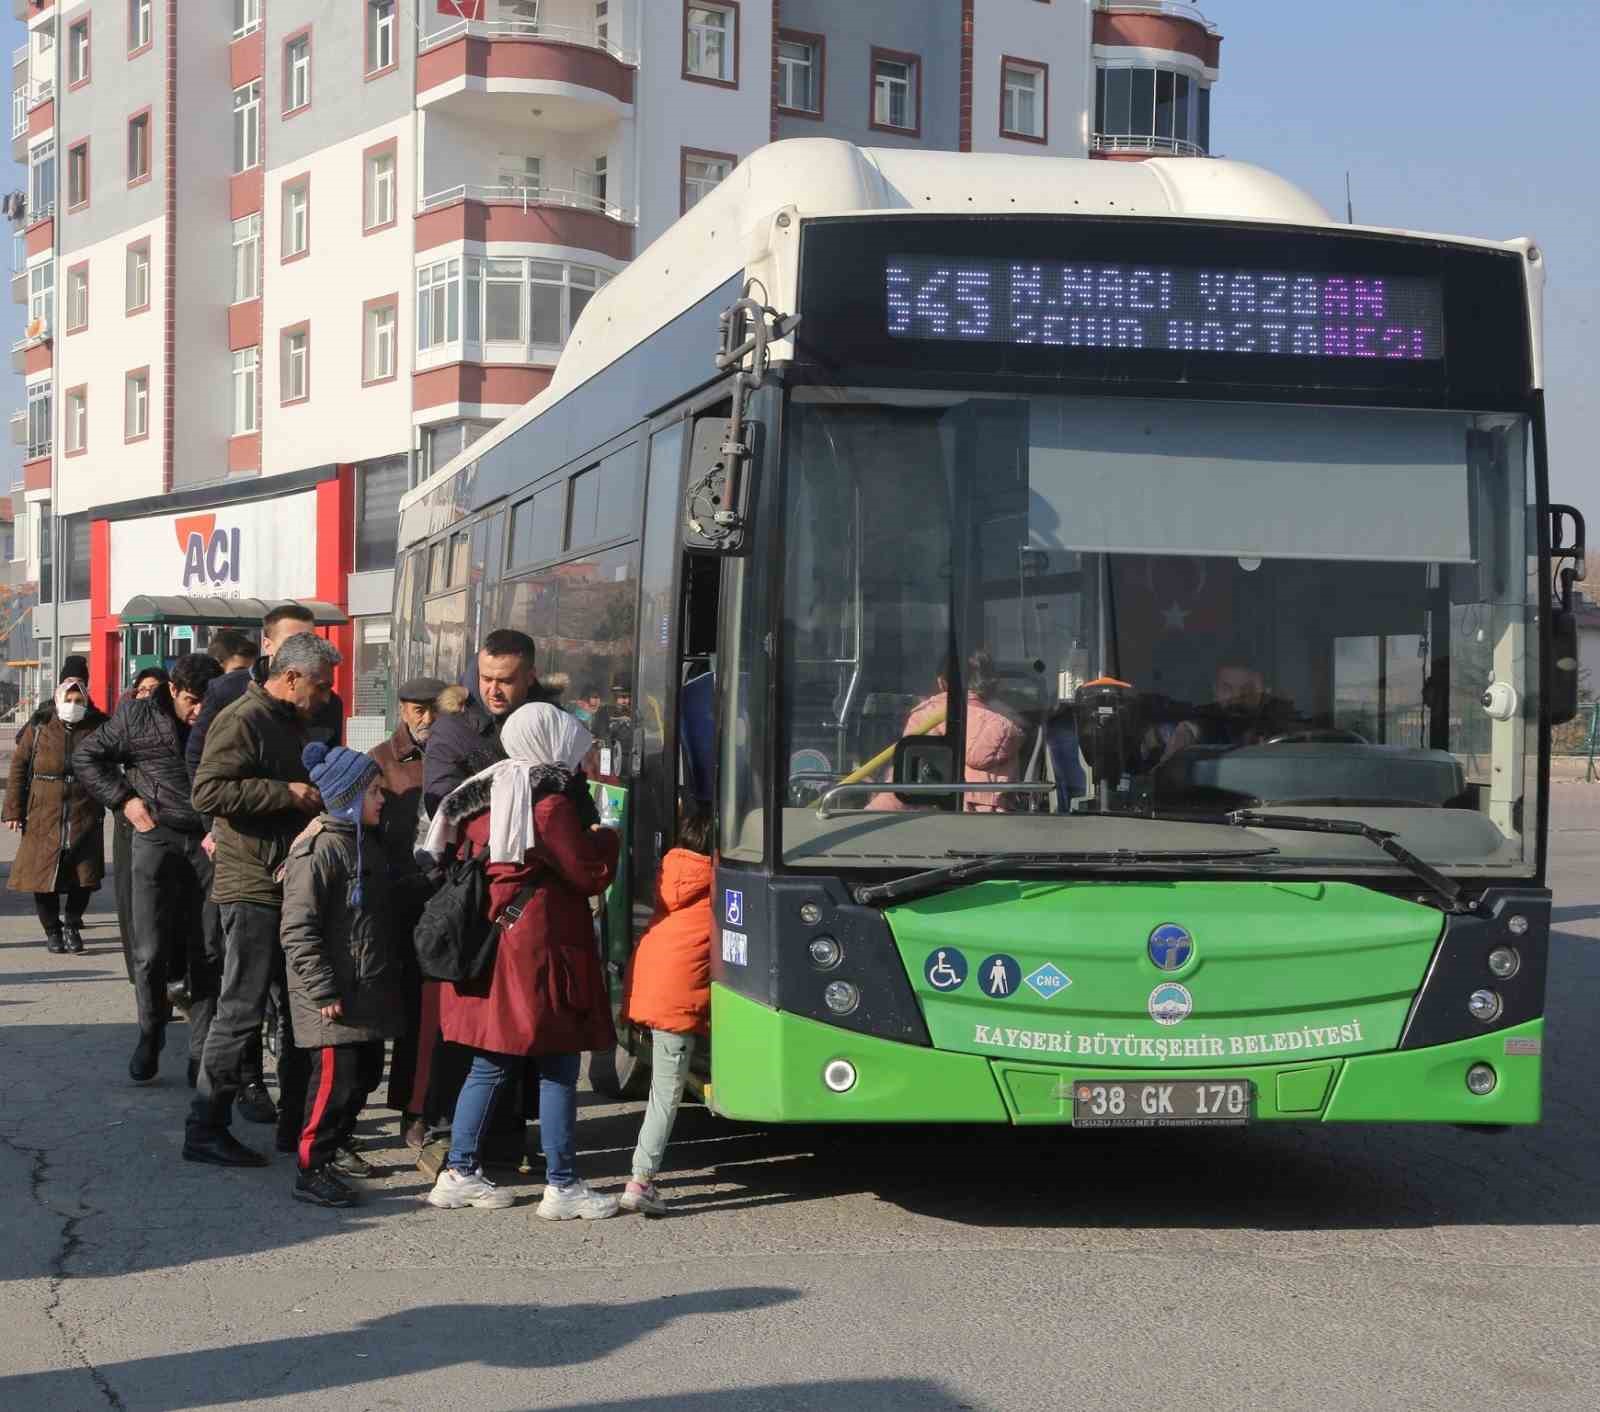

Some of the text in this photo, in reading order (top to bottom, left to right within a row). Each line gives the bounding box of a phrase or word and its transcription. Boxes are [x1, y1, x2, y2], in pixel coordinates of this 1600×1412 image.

[1036, 975, 1060, 986] CNG
[972, 1018, 1364, 1061] KAYSERİ BÜYÜKŞEHİR BELEDİYESİ
[1091, 1085, 1244, 1115] 38 GK 170
